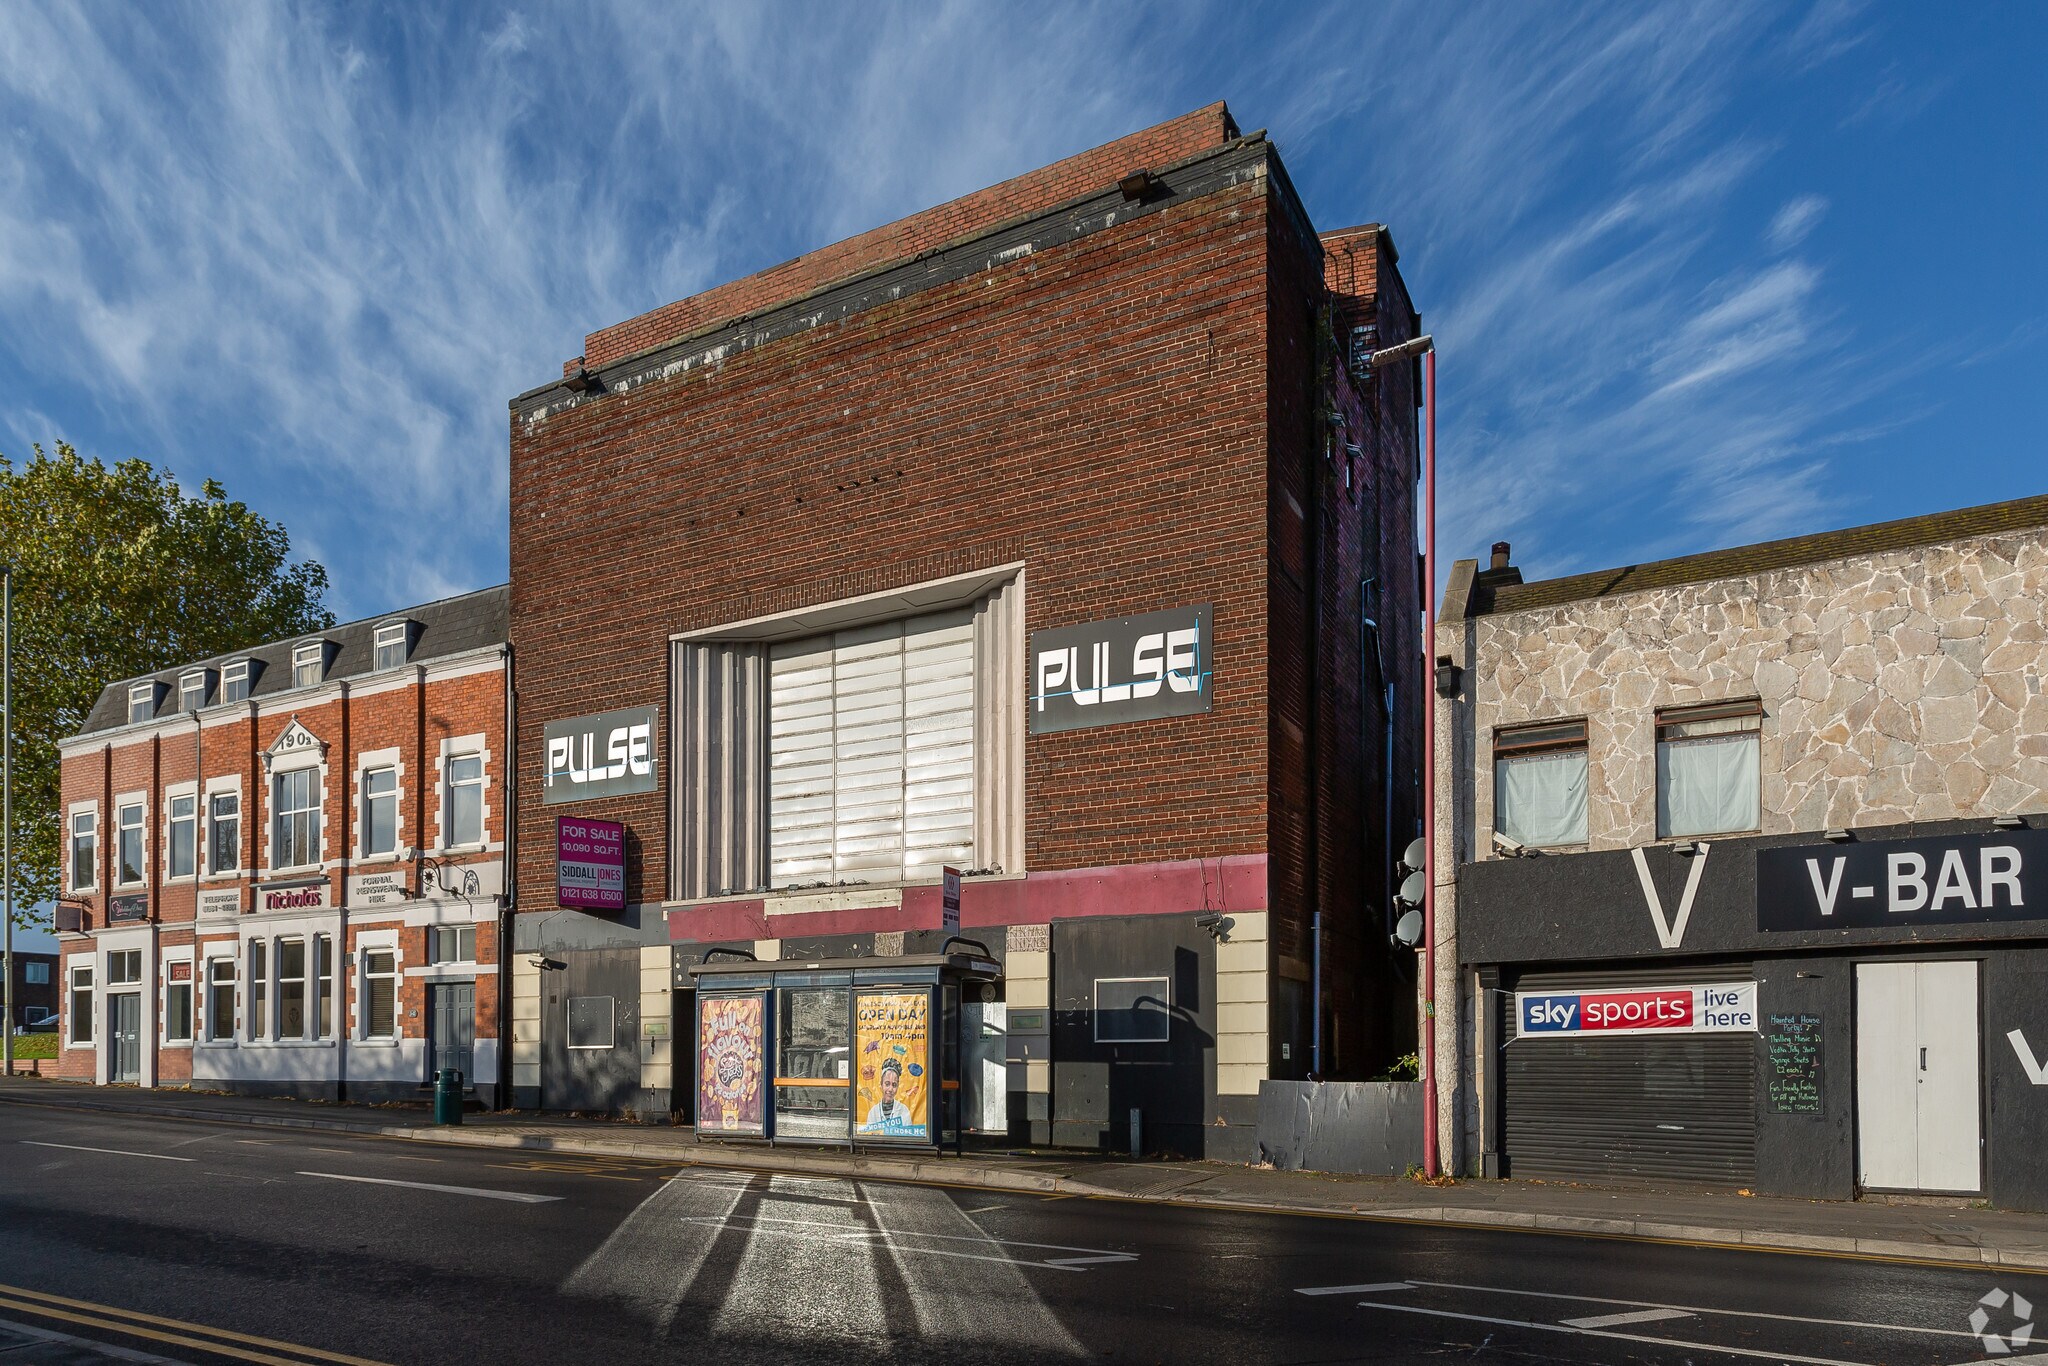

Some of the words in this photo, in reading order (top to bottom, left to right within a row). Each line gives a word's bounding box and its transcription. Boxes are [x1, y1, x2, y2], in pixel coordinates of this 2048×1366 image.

[1037, 627, 1200, 712] PULSE
[548, 723, 650, 787] PULSE
[562, 825, 586, 838] FOR
[590, 828, 619, 841] SALE
[562, 842, 590, 853] 10,090
[362, 876, 393, 885] FORMAL
[562, 866, 596, 879] SIDDALL
[596, 868, 621, 887] JONES
[266, 888, 322, 910] nicholas
[369, 895, 386, 903] HIRE
[562, 888, 580, 898] 0121
[582, 889, 598, 899] 638
[601, 891, 621, 900] 0500
[1630, 842, 1711, 948] V
[176, 970, 190, 979] SALE
[1704, 990, 1738, 1006] live
[859, 1009, 894, 1021] OPEN
[898, 1008, 926, 1020] DAY
[1530, 1000, 1576, 1028] sky
[1587, 997, 1686, 1026] sports
[1704, 1010, 1751, 1026] here
[1801, 1015, 1820, 1024] House
[885, 1118, 901, 1127] YOU
